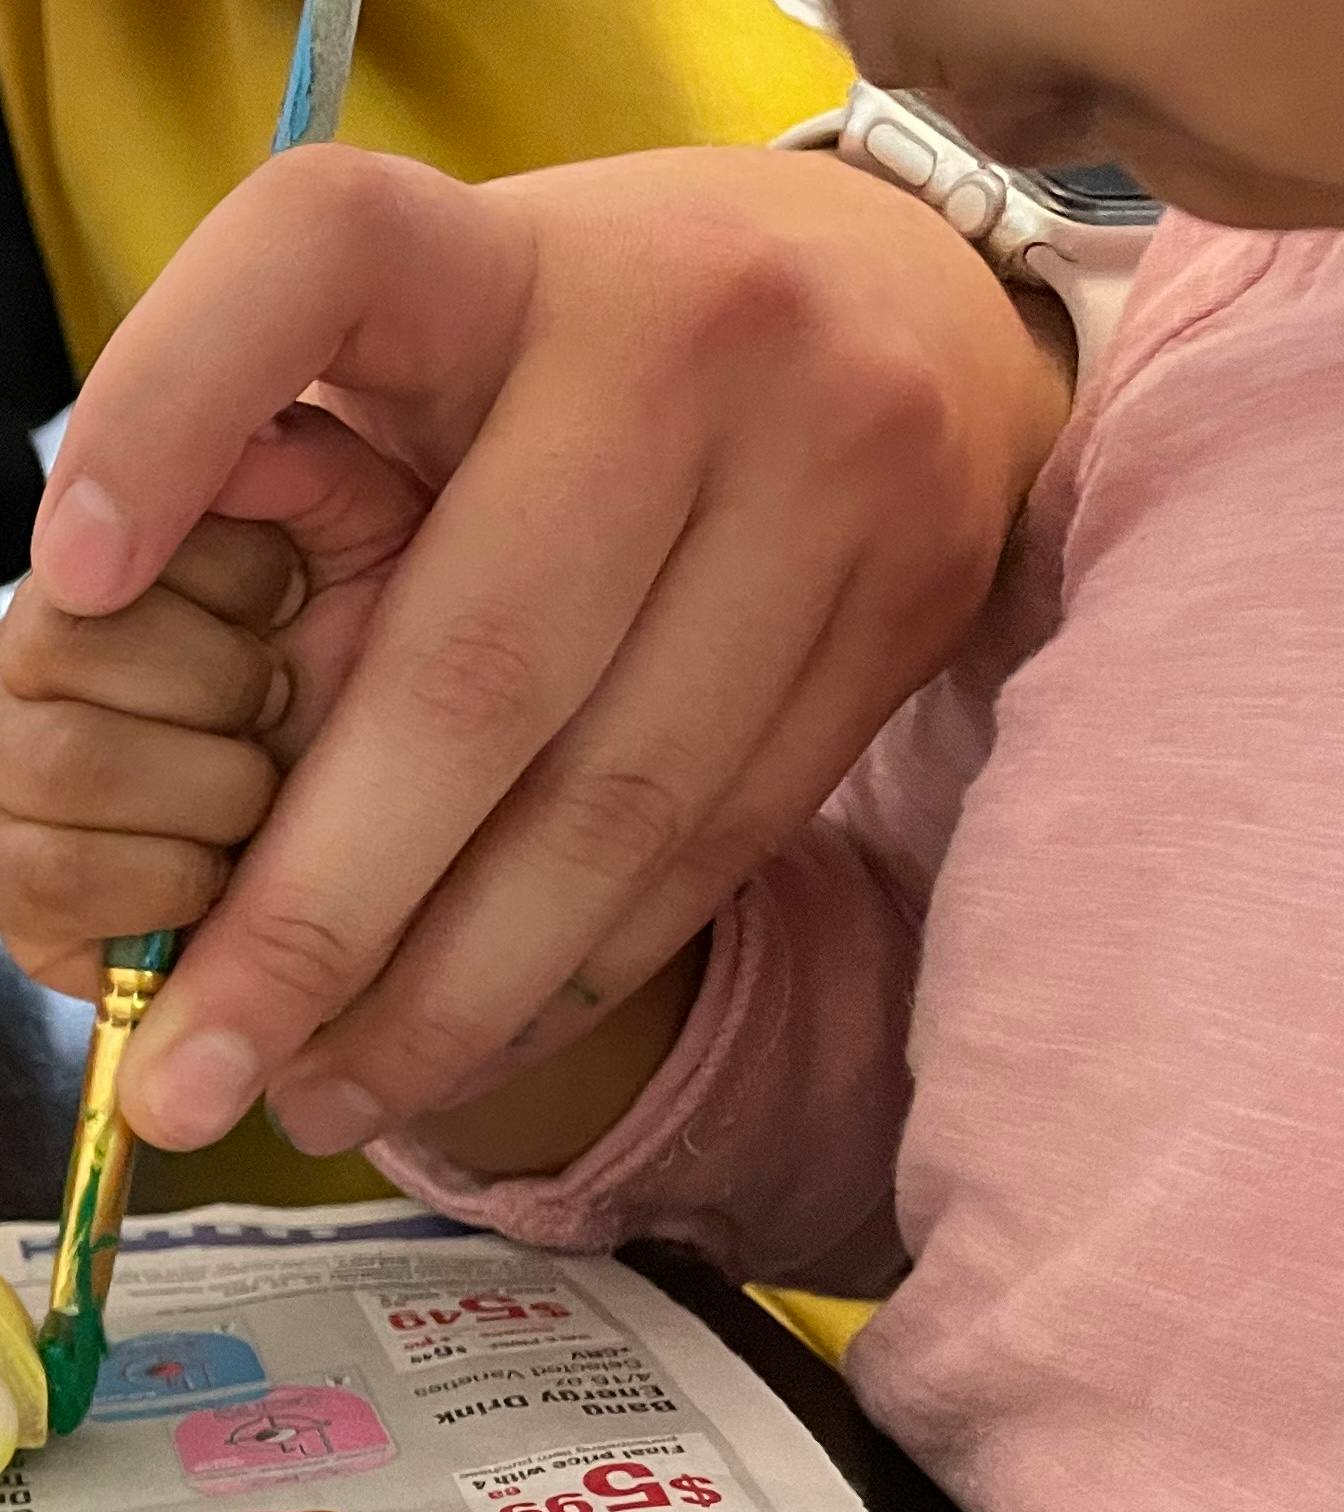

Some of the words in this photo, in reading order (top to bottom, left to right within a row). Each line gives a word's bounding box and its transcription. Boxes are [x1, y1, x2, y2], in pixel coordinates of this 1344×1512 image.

[541, 1385, 665, 1404] Energy
[433, 1395, 529, 1425] Drink
[581, 1399, 677, 1417] Bang
